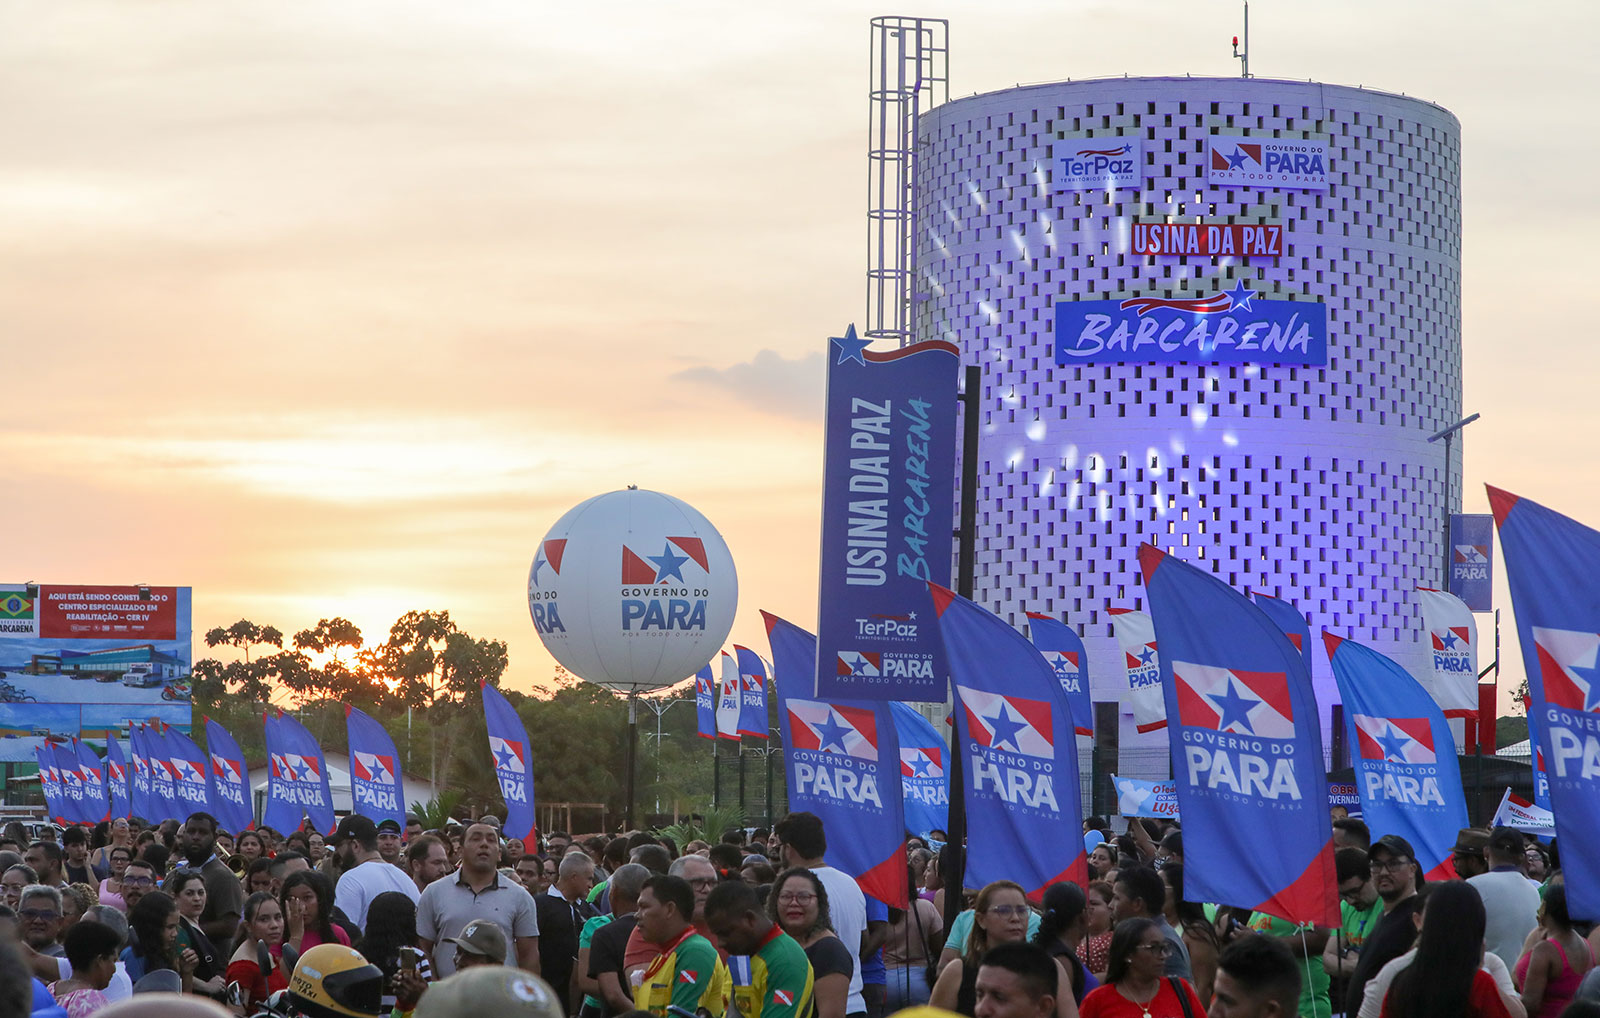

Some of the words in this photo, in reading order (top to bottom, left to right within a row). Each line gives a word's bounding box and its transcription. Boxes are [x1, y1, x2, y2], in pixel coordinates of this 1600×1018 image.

[1265, 145, 1307, 153] GOVERNO
[1060, 158, 1134, 176] TerPaz
[1265, 152, 1325, 175] PARÁ
[1241, 173, 1279, 181] TODO
[1133, 224, 1200, 254] USINA
[1208, 225, 1235, 254] DA
[1242, 226, 1280, 255] PAZ
[1063, 312, 1314, 357] BARCARENA
[850, 397, 891, 451] PAZ
[849, 456, 890, 494] DA
[897, 396, 933, 591] BARCARENA
[846, 499, 889, 587] USINA
[67, 592, 85, 600] ESTÁ
[544, 591, 557, 599] DO
[621, 588, 688, 597] GOVERNO
[693, 588, 709, 597] DO
[66, 613, 118, 621] REABILITAÇÃO
[533, 602, 566, 634] RÁ
[621, 599, 707, 630] PARÁ
[855, 618, 917, 637] TerPaz
[883, 659, 934, 679] PARÁ
[1128, 664, 1156, 674] GOVERNO
[1433, 655, 1473, 673] PARÁ
[1182, 730, 1263, 753] GOVERNO
[1271, 743, 1295, 755] DO
[793, 751, 853, 768] GOVERNO
[859, 763, 877, 773] DO
[1033, 760, 1053, 773] DO
[1362, 761, 1413, 776] GOVERNO
[1419, 766, 1437, 776] DO
[1184, 745, 1303, 801] PARÁ
[354, 777, 386, 791] GOVERNO
[794, 762, 883, 809] PARÁ
[1364, 771, 1446, 806] PARÁ
[354, 783, 399, 812] PARÁ
[298, 986, 318, 999] TAXI
